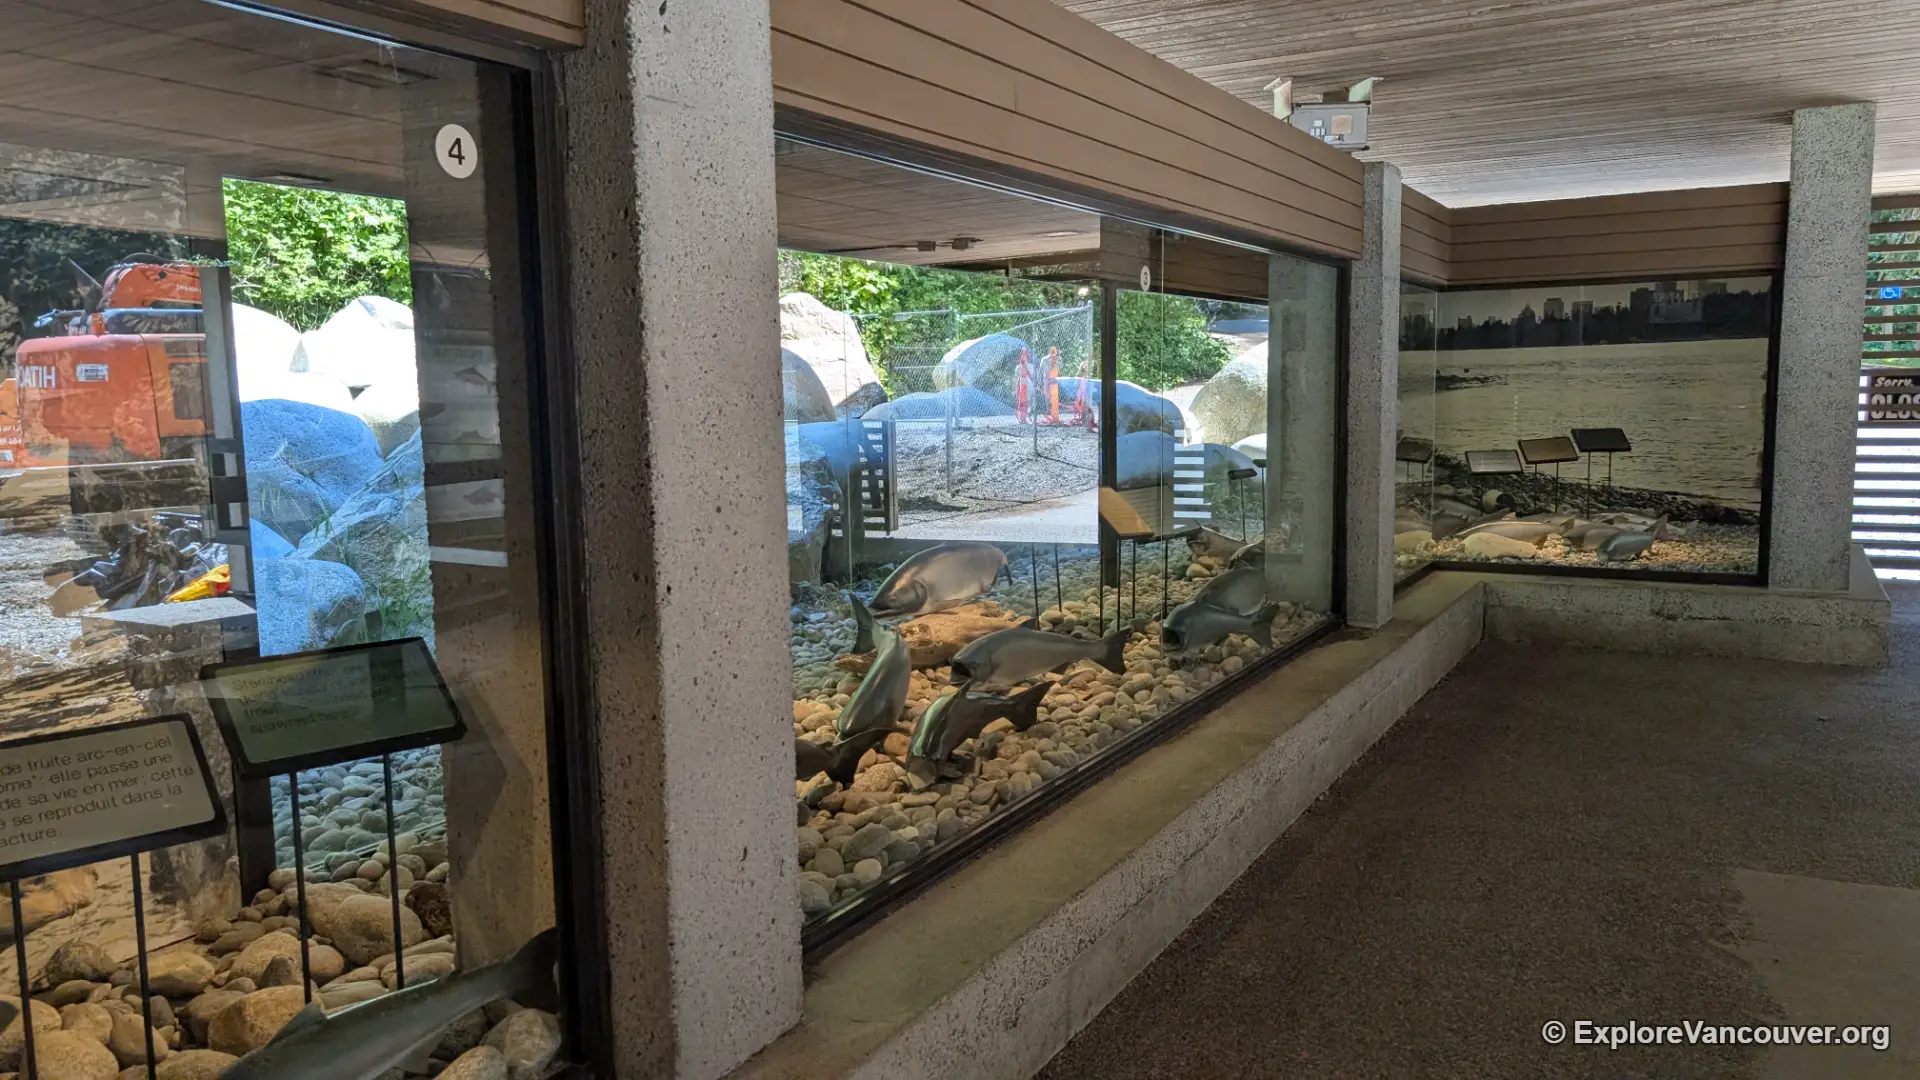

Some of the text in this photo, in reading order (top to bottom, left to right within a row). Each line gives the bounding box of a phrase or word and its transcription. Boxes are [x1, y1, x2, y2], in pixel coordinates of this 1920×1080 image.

[448, 137, 465, 165] 4
[1143, 271, 1149, 286] 3
[27, 754, 72, 771] truite
[76, 736, 171, 763] arc-en-ciel
[49, 768, 82, 784] elle
[87, 760, 139, 779] passe
[143, 753, 173, 768] une
[0, 797, 21, 811] de
[28, 793, 49, 805] sa
[52, 787, 78, 800] vie
[83, 782, 104, 795] en
[150, 766, 194, 782] cette
[12, 813, 34, 827] se
[38, 795, 118, 822] reproduit
[122, 789, 163, 806] dans
[166, 783, 183, 797] la
